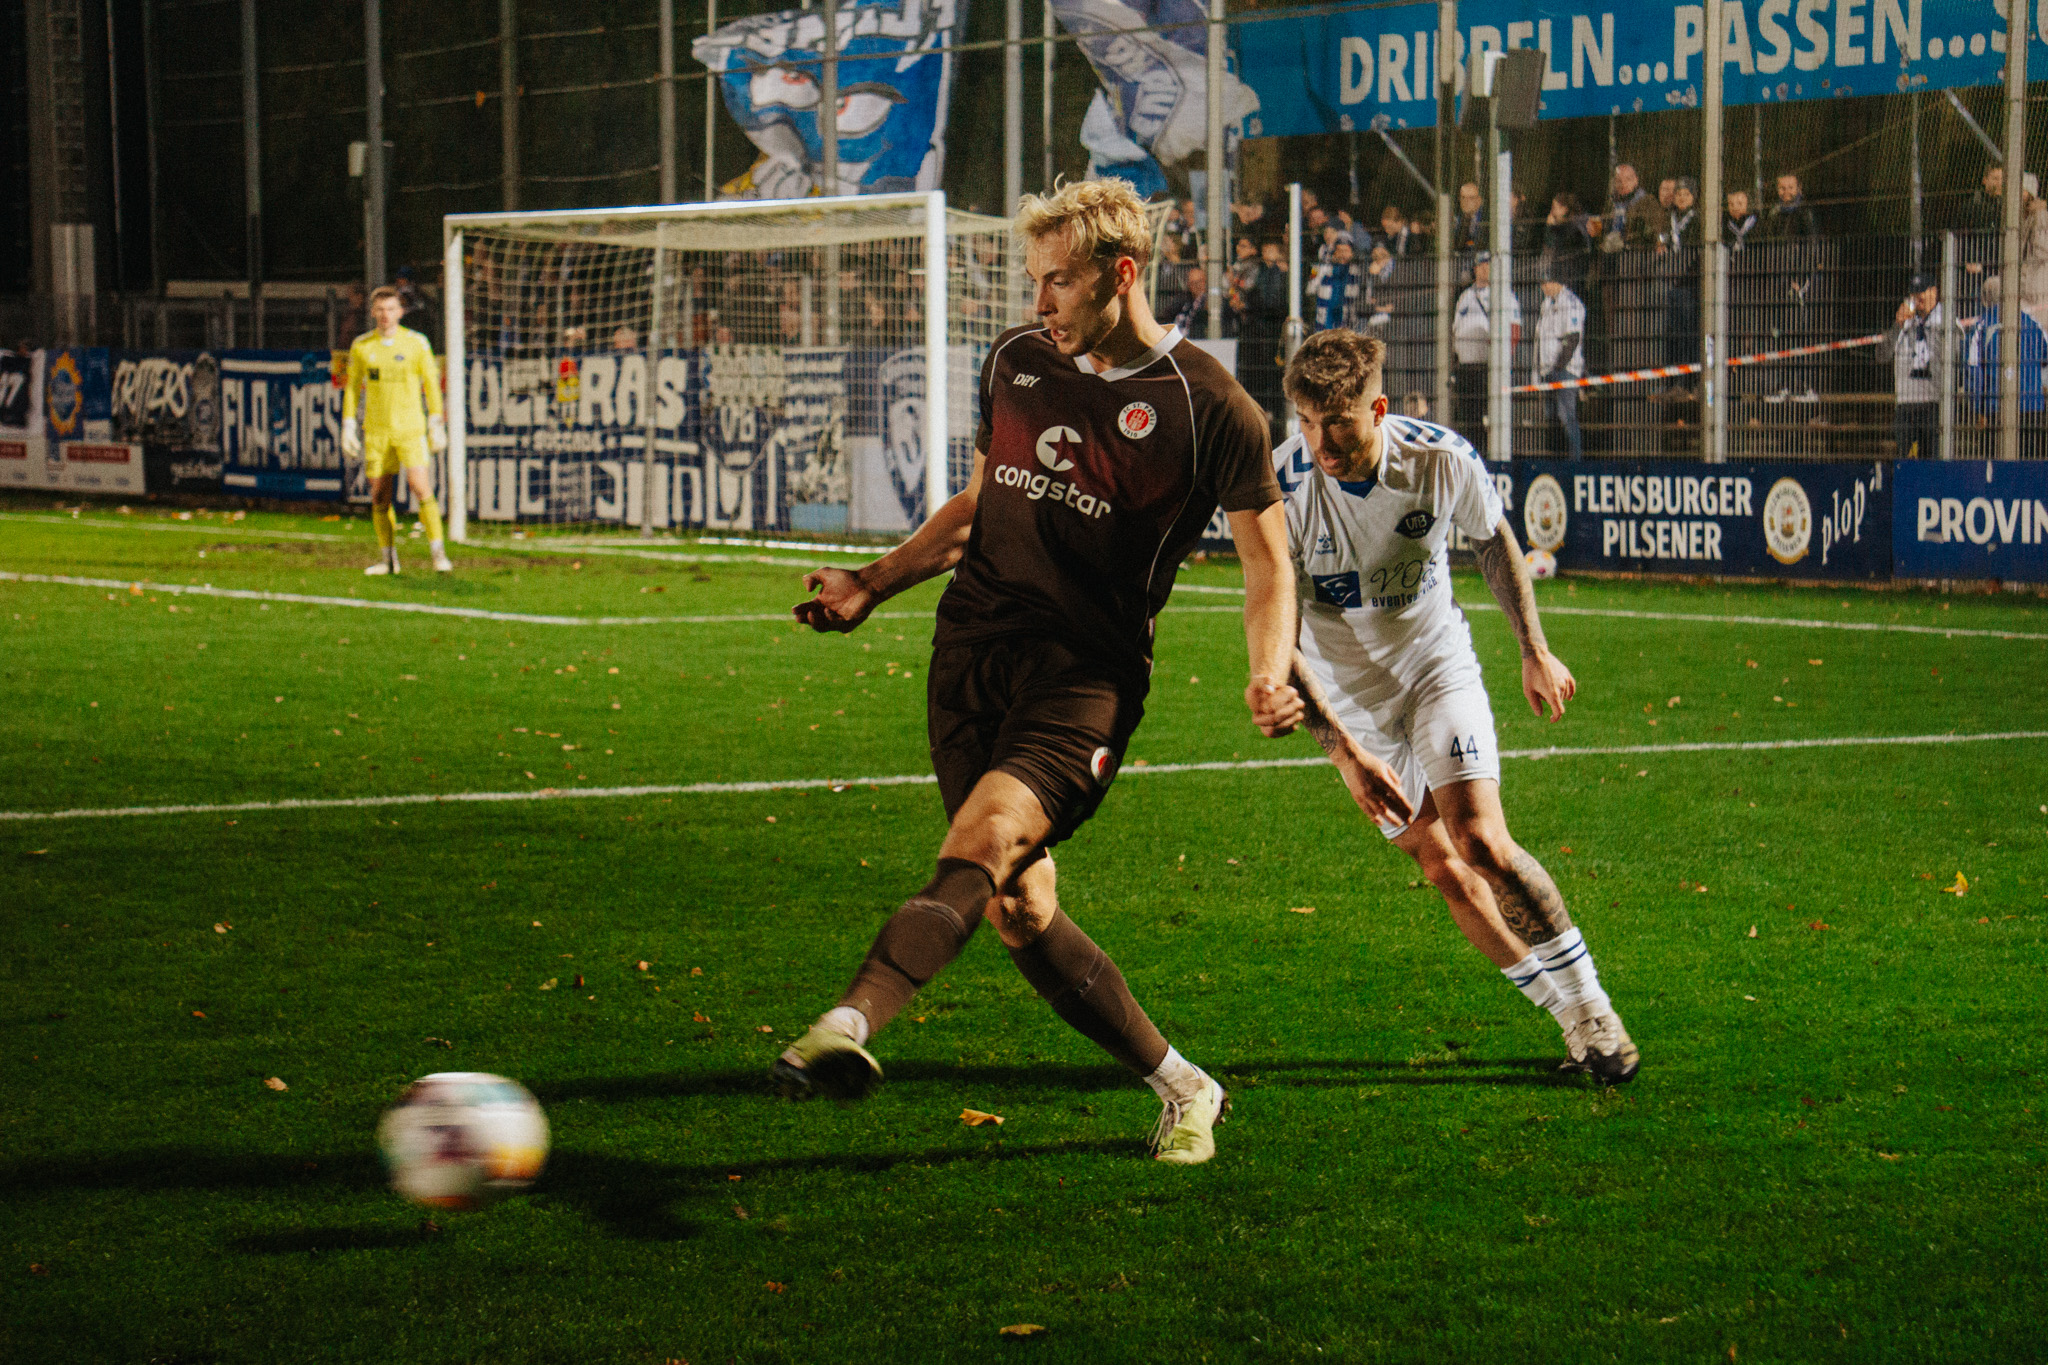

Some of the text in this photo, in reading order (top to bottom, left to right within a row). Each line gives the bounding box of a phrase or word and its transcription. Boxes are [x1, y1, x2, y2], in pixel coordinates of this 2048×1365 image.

[995, 464, 1112, 519] congstar
[1574, 474, 1753, 517] FLENSBURGER
[1603, 519, 1723, 561] PILSENER
[1918, 497, 2048, 545] PROVIN
[1450, 735, 1479, 763] 44
